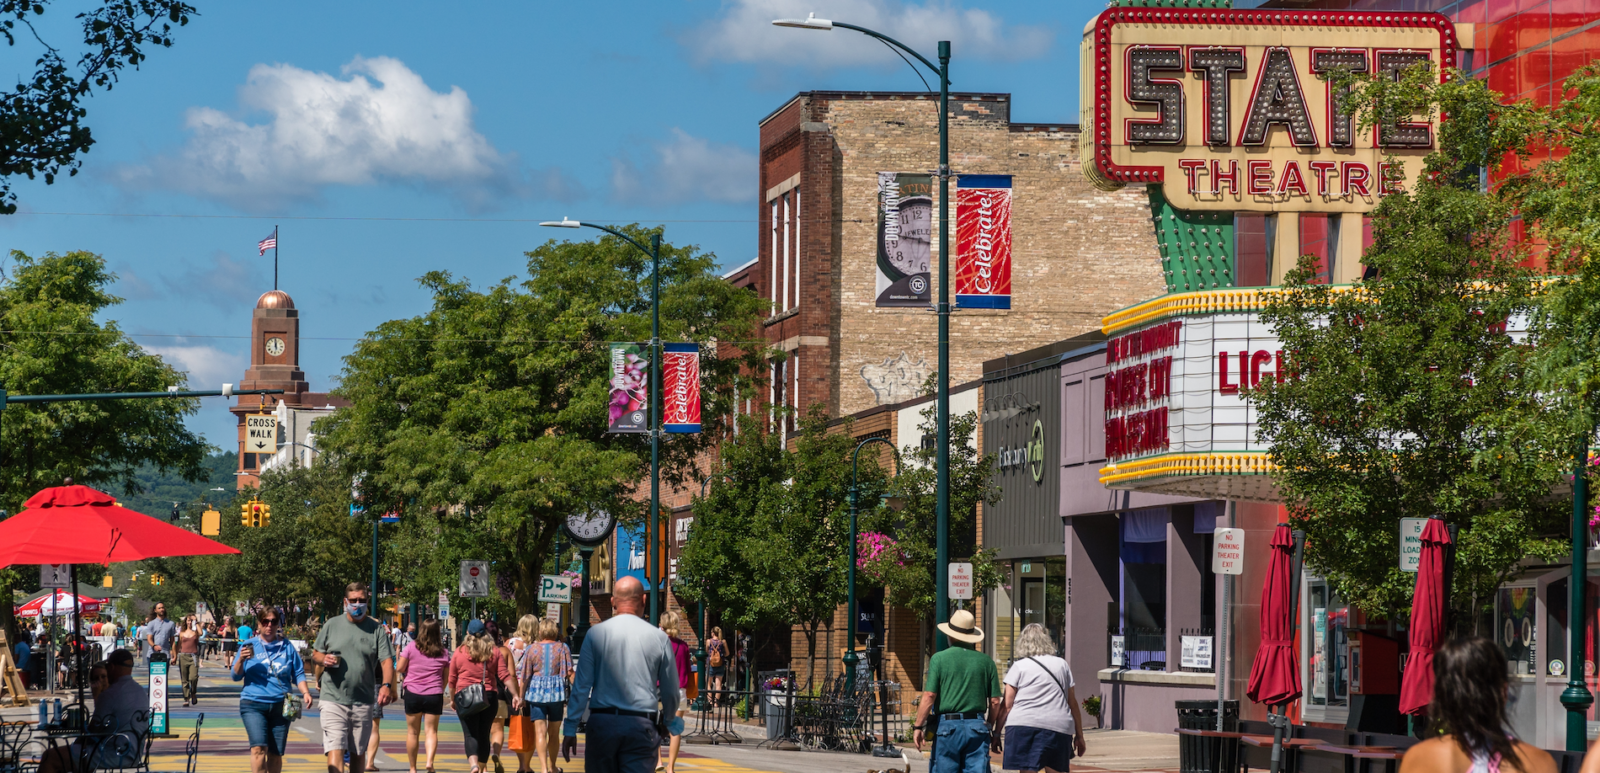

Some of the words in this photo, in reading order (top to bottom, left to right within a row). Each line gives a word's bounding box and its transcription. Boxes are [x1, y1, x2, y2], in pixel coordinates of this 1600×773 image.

[1124, 45, 1434, 148] STATE
[1178, 159, 1404, 198] THEATRE
[885, 182, 900, 241] DOWNTOWN
[975, 190, 994, 294] Celebrate!
[896, 251, 904, 262] 8
[614, 349, 625, 389] DOWNTOWN
[676, 354, 688, 423] Celebrate!
[248, 418, 276, 428] CROSS
[250, 429, 272, 439] WALK
[584, 528, 590, 536] 6
[593, 526, 598, 534] 5
[1413, 525, 1421, 533] 15
[1405, 536, 1422, 544] MINU
[1403, 546, 1421, 554] LOAD
